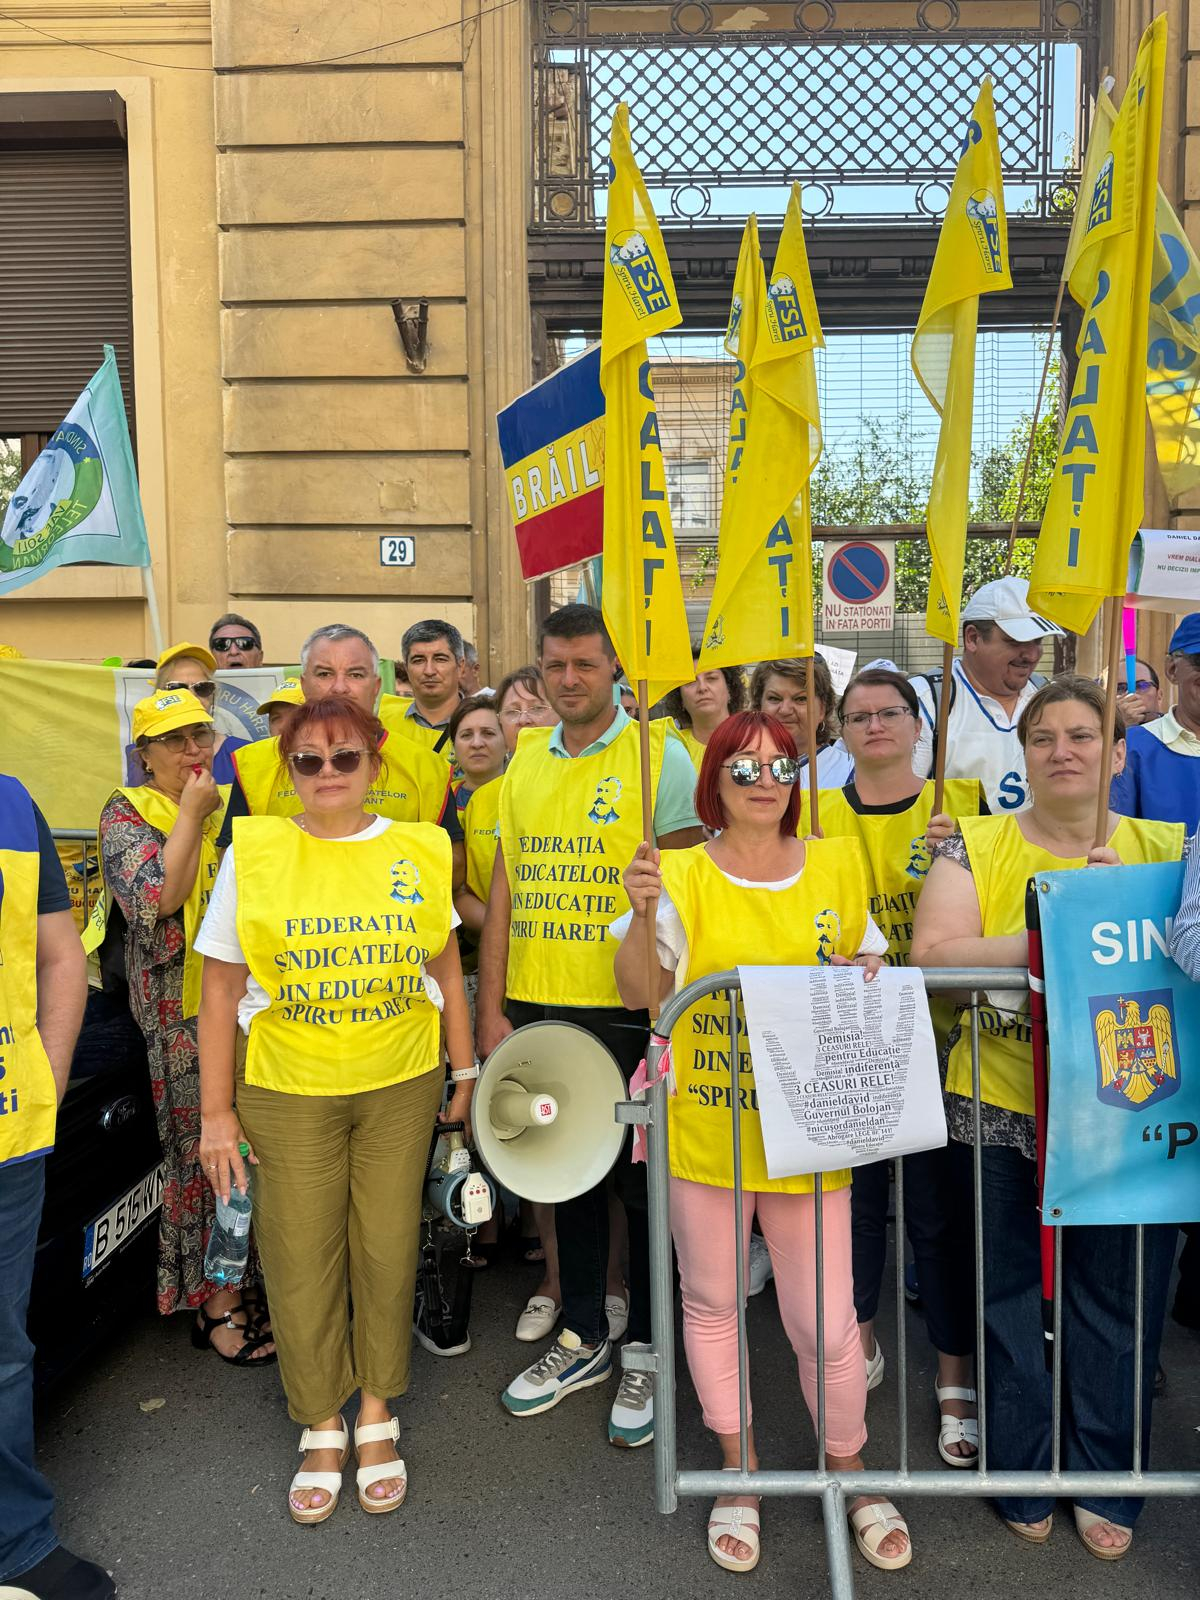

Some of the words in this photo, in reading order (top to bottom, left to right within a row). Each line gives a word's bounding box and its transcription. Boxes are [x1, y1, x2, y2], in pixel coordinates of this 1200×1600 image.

[617, 267, 634, 290] Spiru
[628, 288, 647, 317] Haret
[631, 255, 669, 312] FSE
[777, 295, 804, 341] FSE
[769, 320, 781, 342] Haret
[511, 440, 600, 520] BRĂIL
[388, 540, 407, 562] 29
[1167, 553, 1184, 561] VREM
[1167, 565, 1189, 573] DECIZII
[825, 604, 841, 617] NU
[525, 893, 616, 917] EDUCAȚIE
[285, 914, 417, 937] FEDERAȚIA
[543, 922, 610, 942] HARET
[818, 1030, 863, 1045] Demisia!
[822, 1043, 851, 1052] CEASURI
[853, 1041, 871, 1049] RELE!
[825, 1052, 857, 1064] pentru
[816, 1068, 842, 1077] Demisia!
[845, 1060, 901, 1072] indiferență
[795, 1085, 800, 1095] 3
[804, 1078, 857, 1094] CEASURI
[860, 1073, 895, 1088] RELE!
[804, 1092, 870, 1108] #danieldavid
[804, 1106, 850, 1120] Guvernul
[853, 1102, 891, 1115] Bolojan
[807, 1117, 885, 1133] #nicușordanieldan
[827, 1132, 853, 1141] Abrogare
[855, 1129, 870, 1137] LEGE
[846, 1136, 885, 1145] #danieldavid
[95, 1218, 110, 1261] B
[115, 1187, 141, 1240] 515
[83, 1252, 93, 1273] RO
